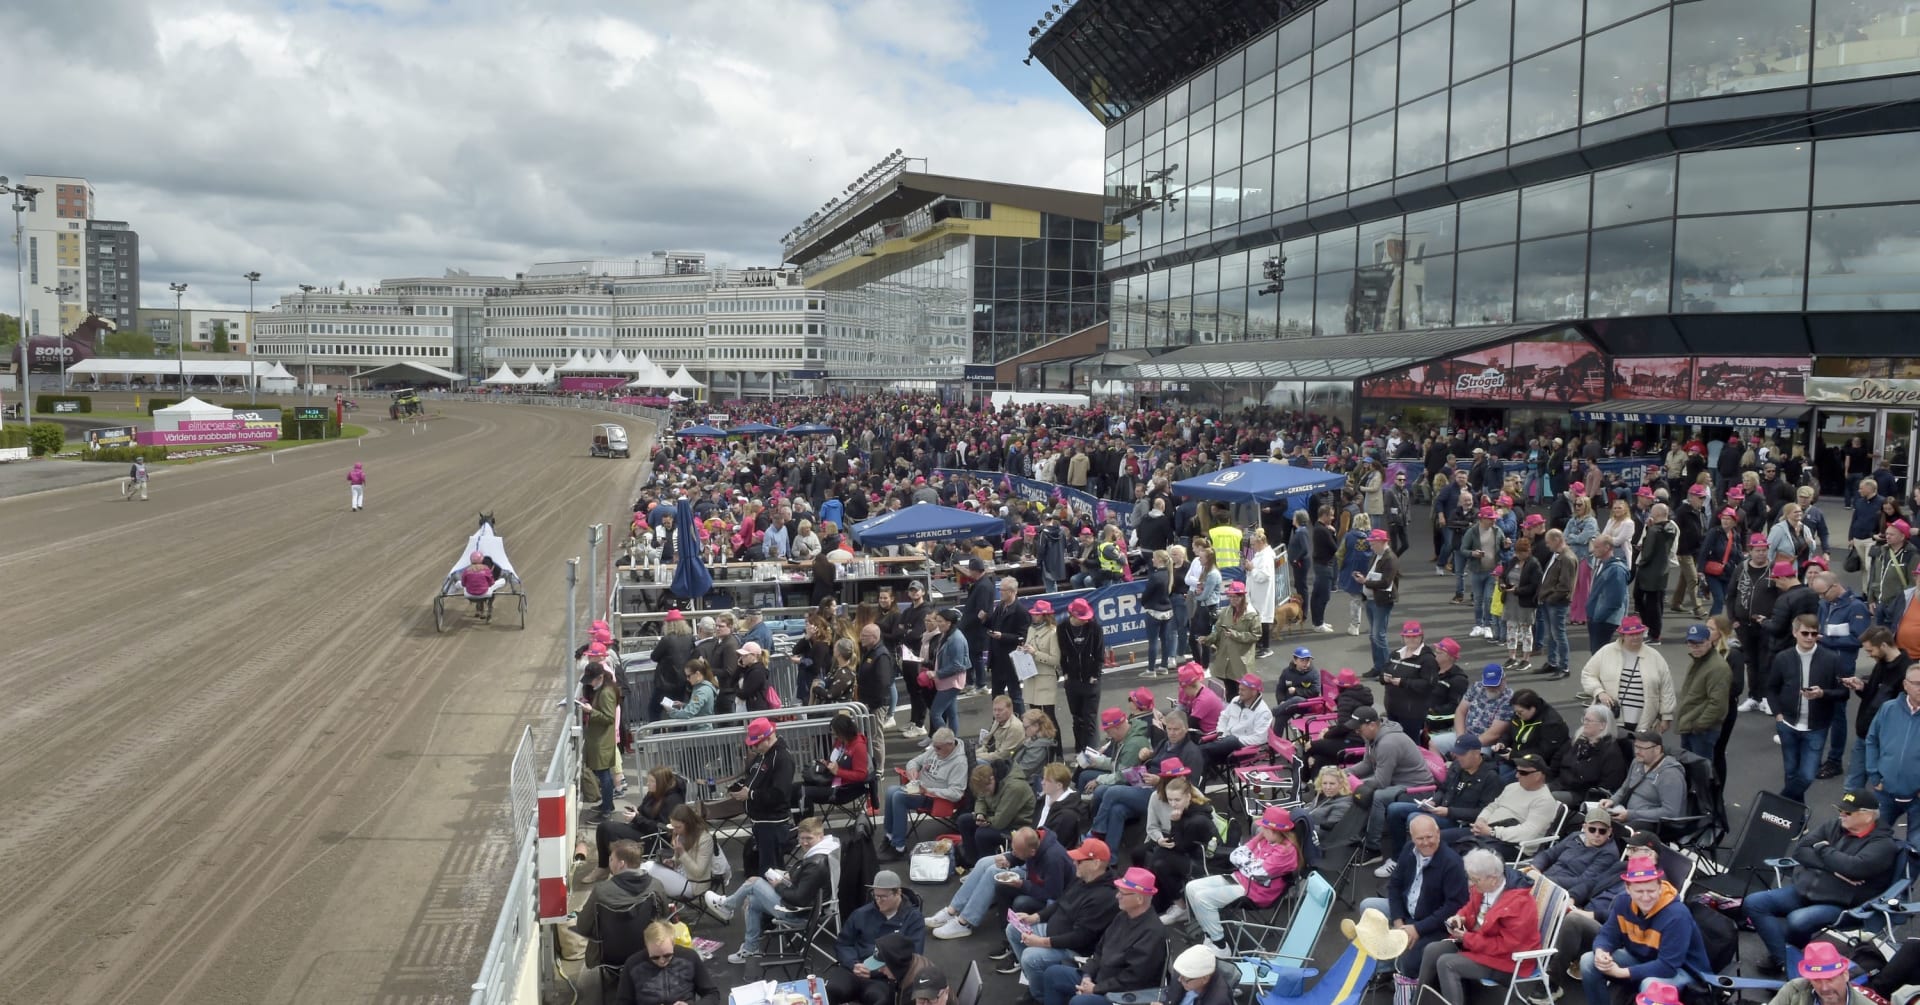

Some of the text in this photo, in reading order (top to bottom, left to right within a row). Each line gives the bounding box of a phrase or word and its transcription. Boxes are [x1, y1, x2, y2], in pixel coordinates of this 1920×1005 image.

[1458, 374, 1504, 388] Ströget
[1590, 412, 1640, 422] BAR BAR
[1685, 415, 1726, 426] GRILL
[164, 430, 273, 442] Världens snabbaste travhästar
